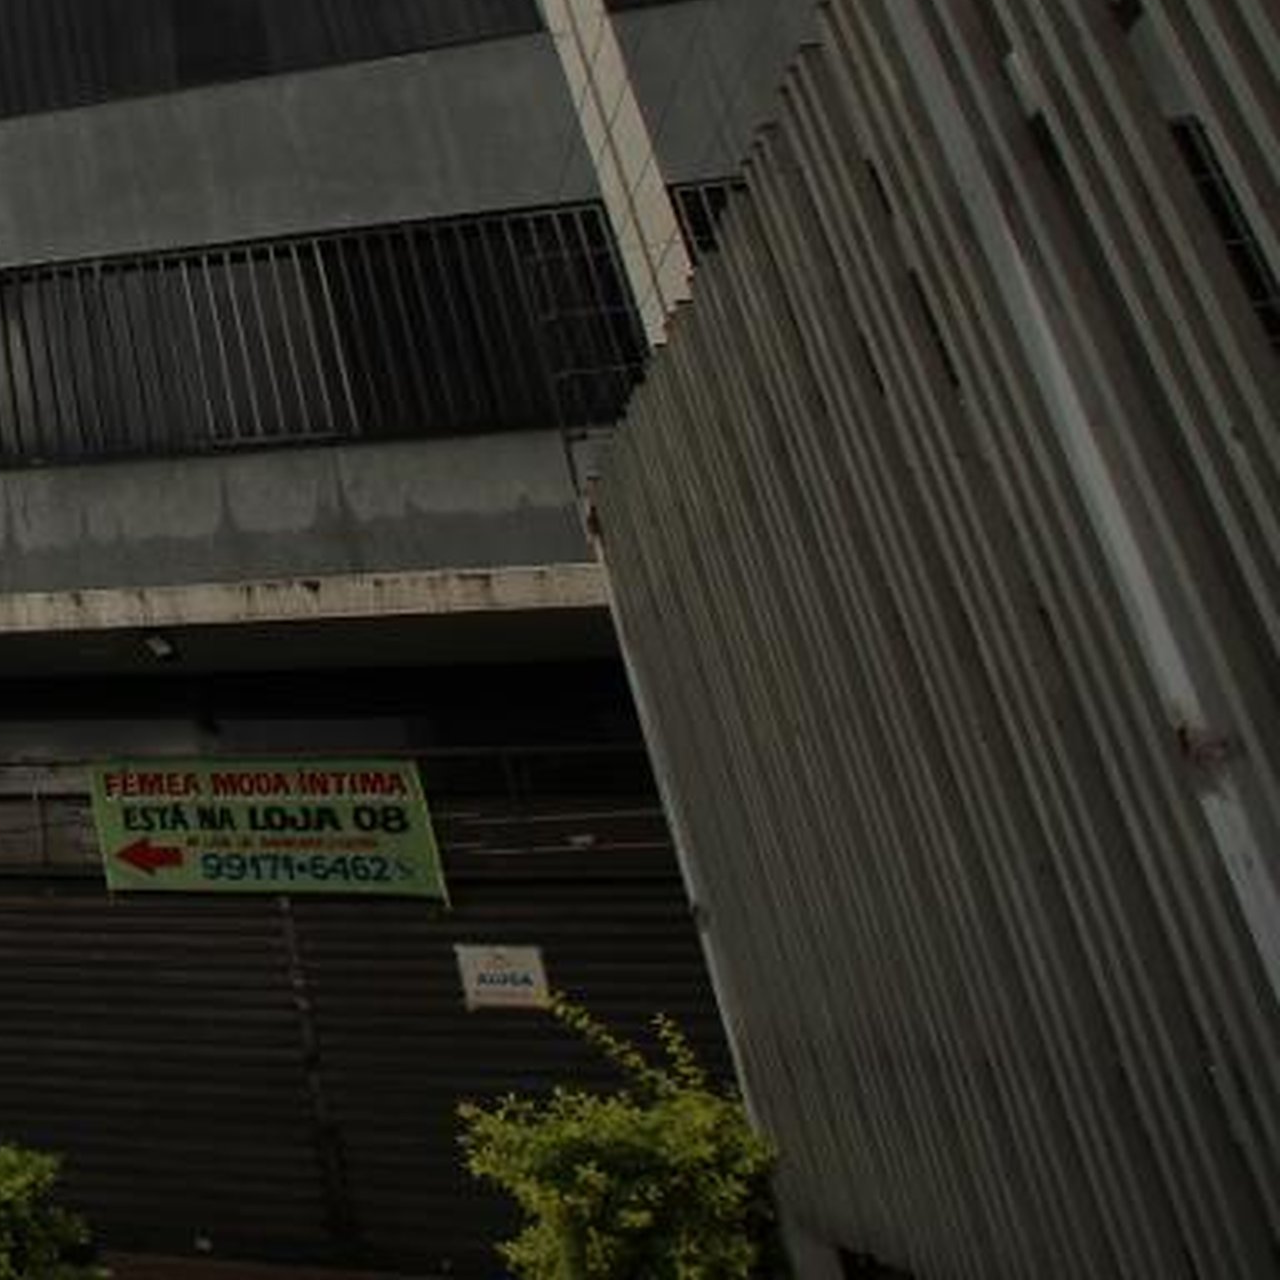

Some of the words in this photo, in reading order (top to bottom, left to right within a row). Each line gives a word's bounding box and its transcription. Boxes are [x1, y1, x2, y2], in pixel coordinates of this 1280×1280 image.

[211, 772, 290, 797] MODA
[197, 806, 236, 831] NA
[248, 806, 342, 832] LOJA
